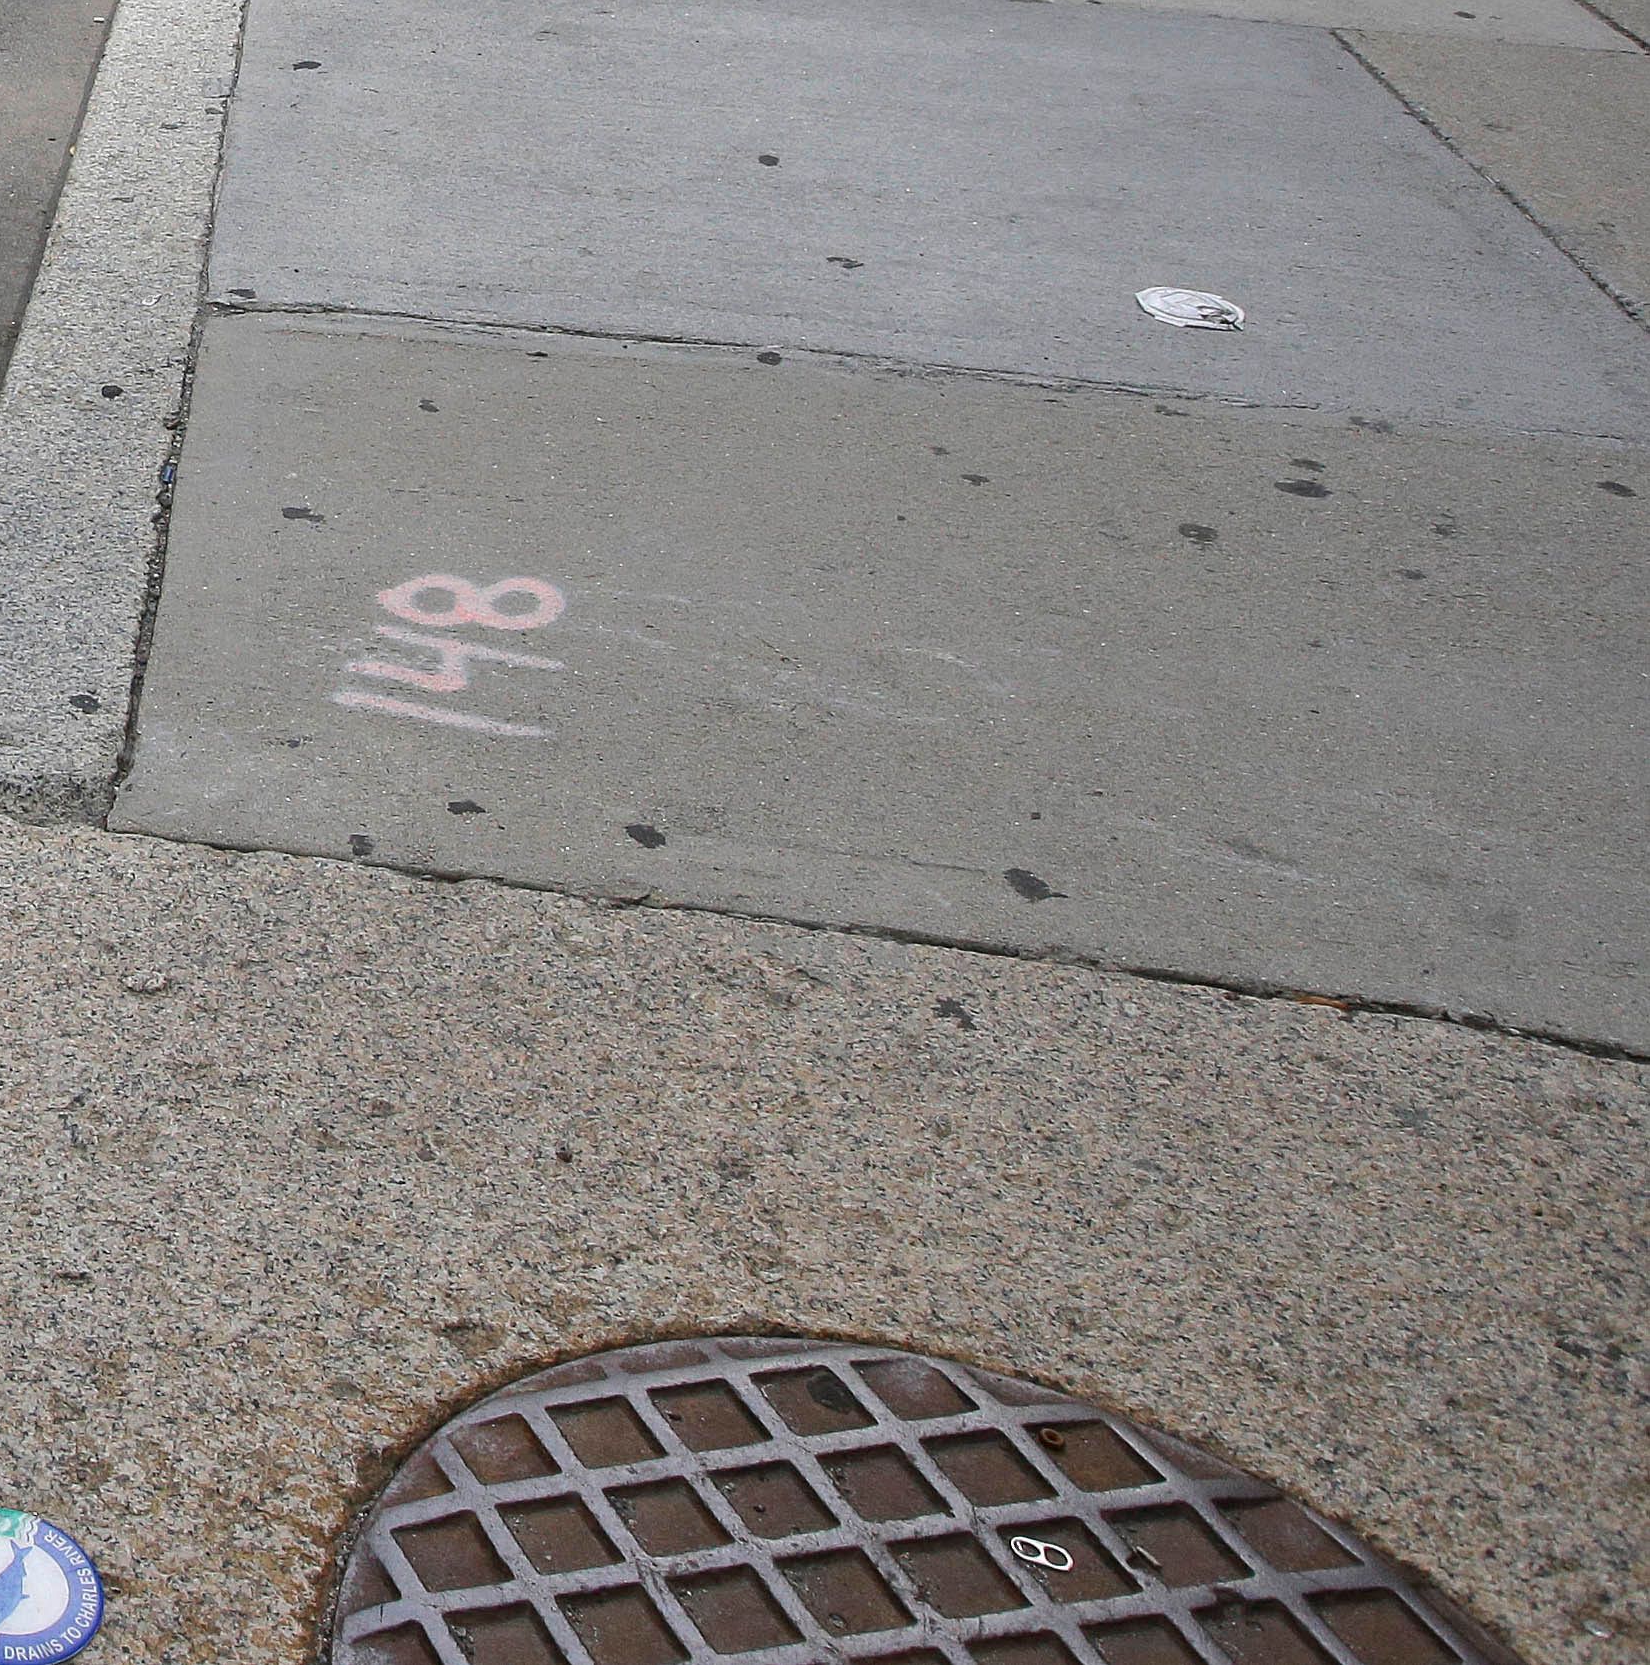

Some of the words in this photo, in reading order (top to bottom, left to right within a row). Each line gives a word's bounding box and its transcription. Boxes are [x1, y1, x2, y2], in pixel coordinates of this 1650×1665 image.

[326, 573, 567, 737] 148
[44, 1530, 85, 1568] RIVER
[74, 1567, 98, 1628] CHARLES
[4, 1638, 64, 1662] DRAINS
[60, 1625, 82, 1645] TO
